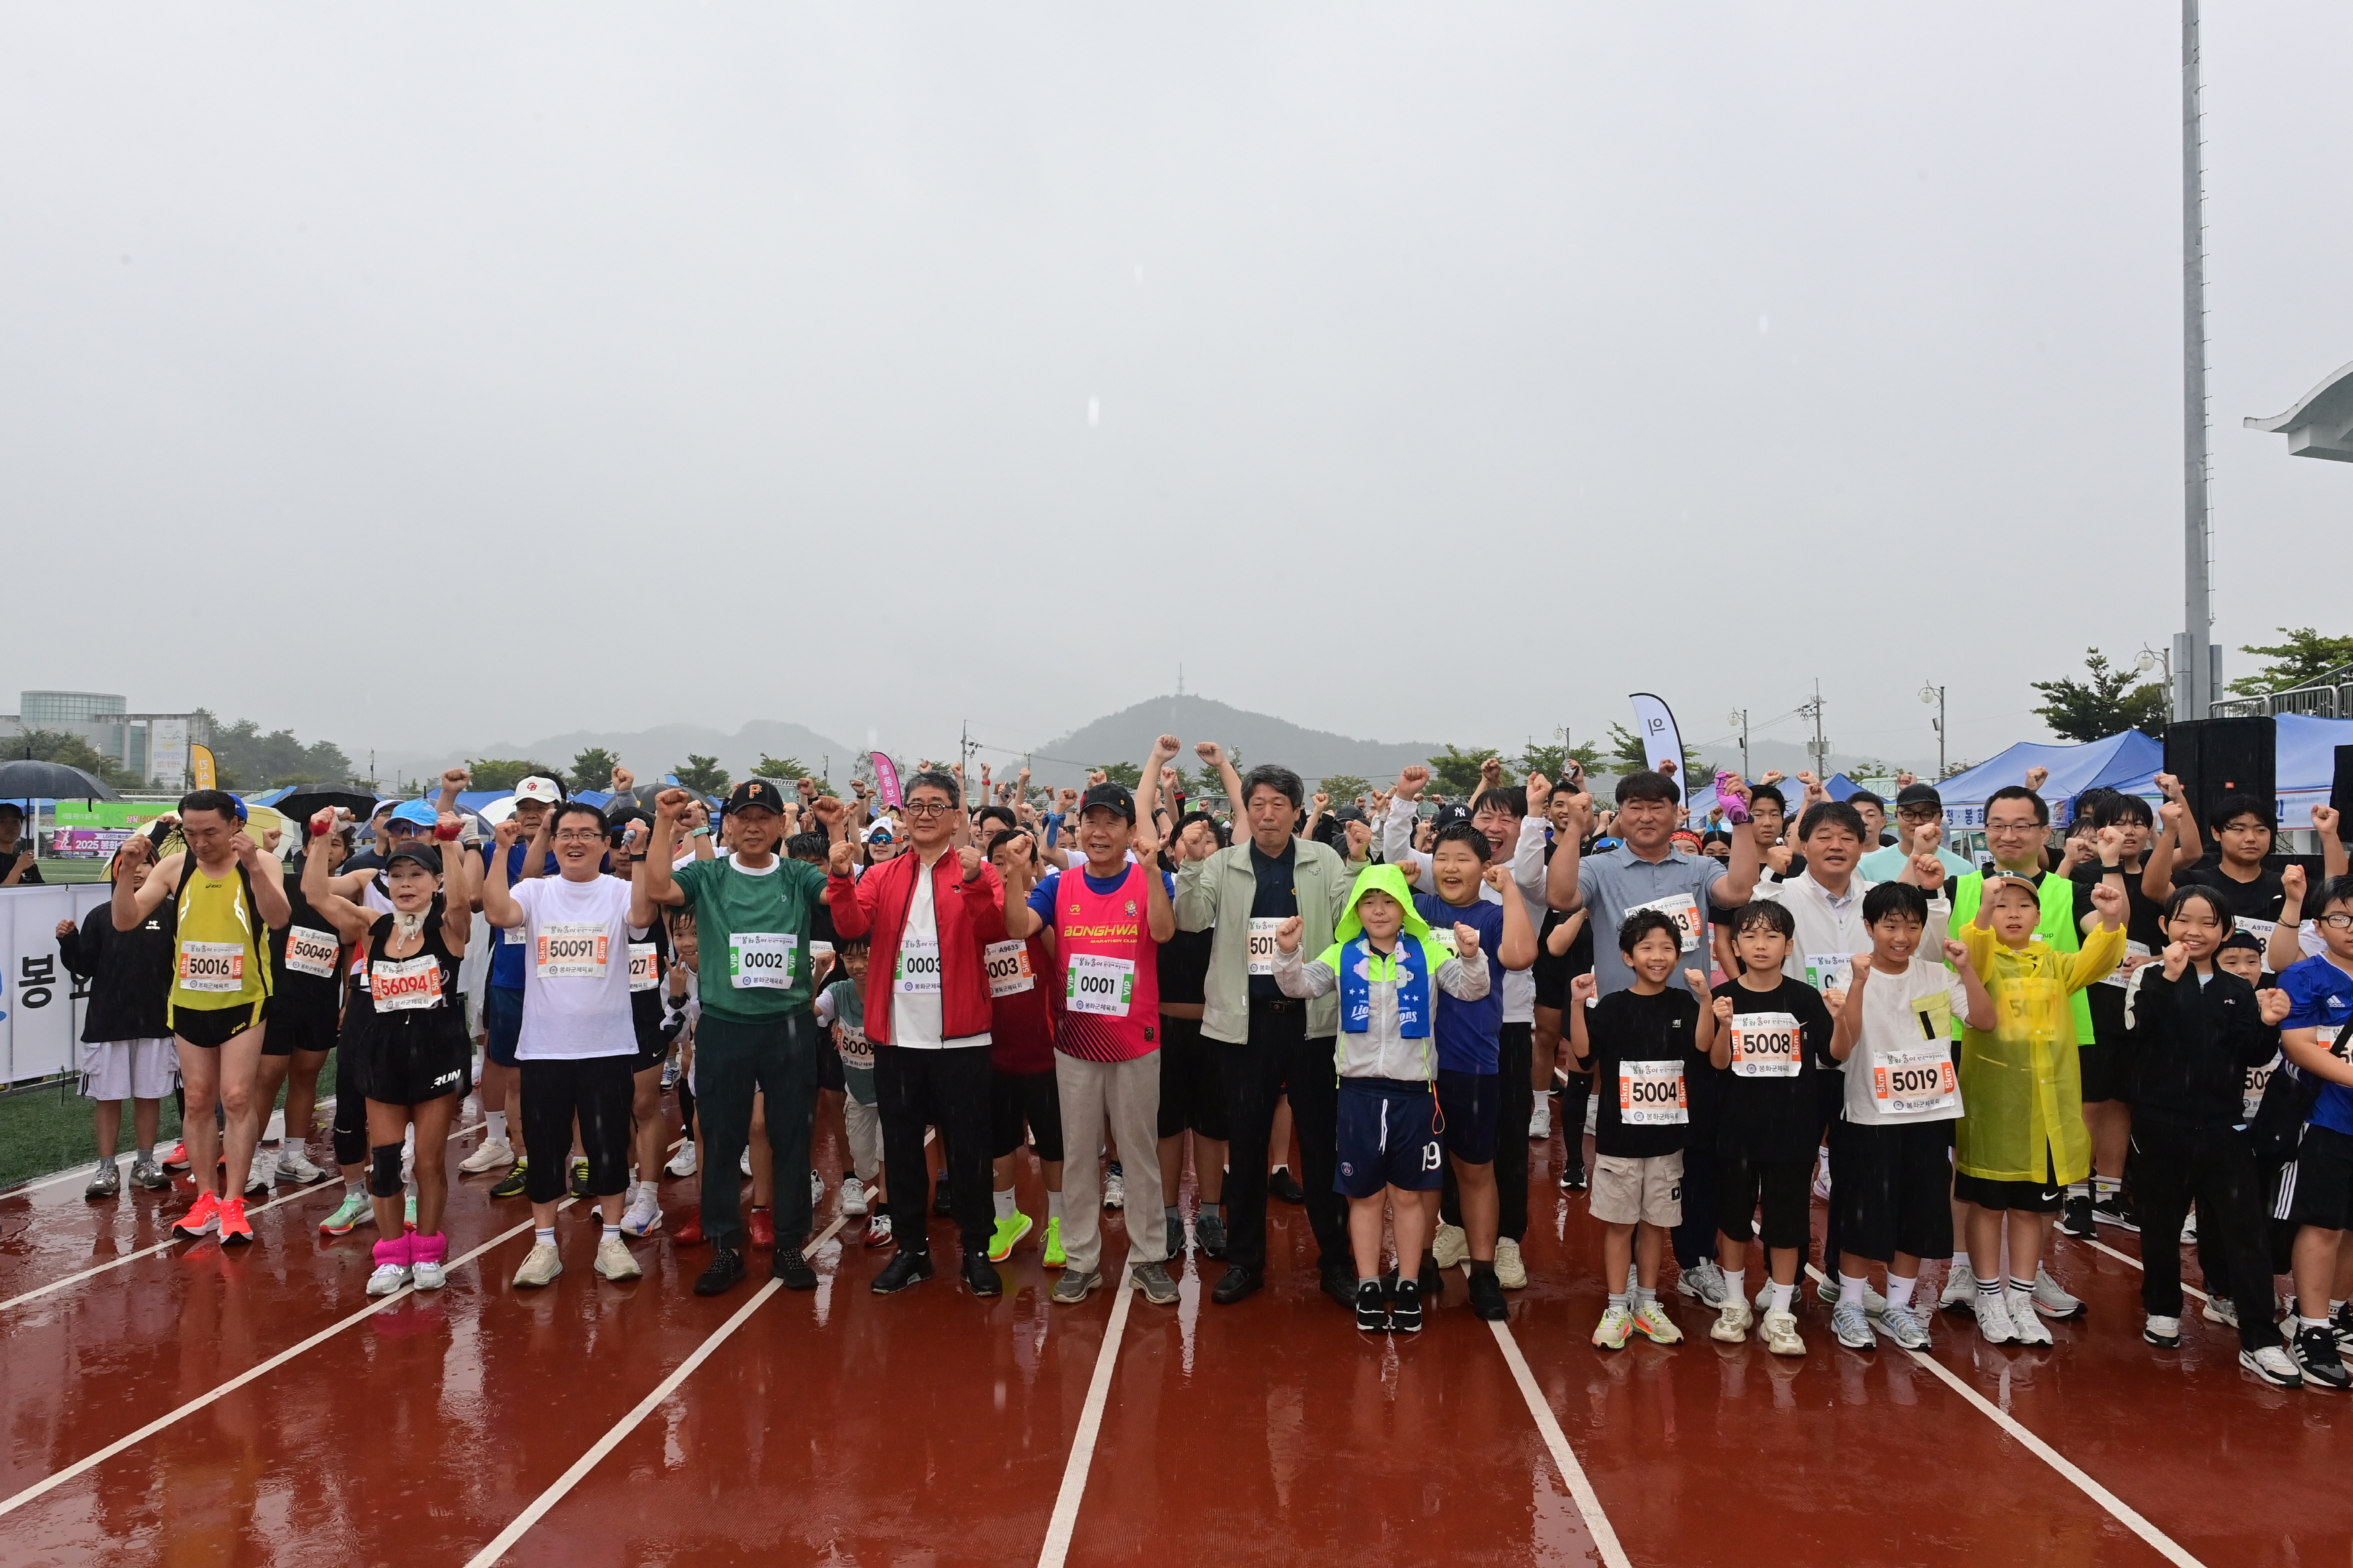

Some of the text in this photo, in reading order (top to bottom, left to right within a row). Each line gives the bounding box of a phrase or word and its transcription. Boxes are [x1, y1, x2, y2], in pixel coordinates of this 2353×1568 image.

[749, 784, 762, 798] P
[1454, 807, 1466, 817] NY
[75, 840, 99, 849] 2025
[1691, 912, 1701, 930] 5km
[1064, 924, 1138, 937] BONGHWA
[294, 941, 332, 961] 50049
[550, 940, 593, 957] 50091
[598, 941, 606, 959] 5km
[999, 944, 1019, 953] A9633
[1250, 937, 1277, 954] 501
[190, 958, 229, 975] 50016
[233, 960, 242, 976] 5km
[745, 952, 783, 968] 0002
[985, 958, 1019, 978] 003
[381, 975, 428, 995] 56094
[431, 973, 439, 991] 5km
[1081, 976, 1115, 994] 0001
[1743, 1033, 1790, 1054] 5008
[1876, 1073, 1886, 1093] 5km
[1892, 1069, 1938, 1091] 5019
[1944, 1067, 1953, 1089] 5km
[1632, 1082, 1677, 1102] 5004
[1421, 1141, 1441, 1171] 19
